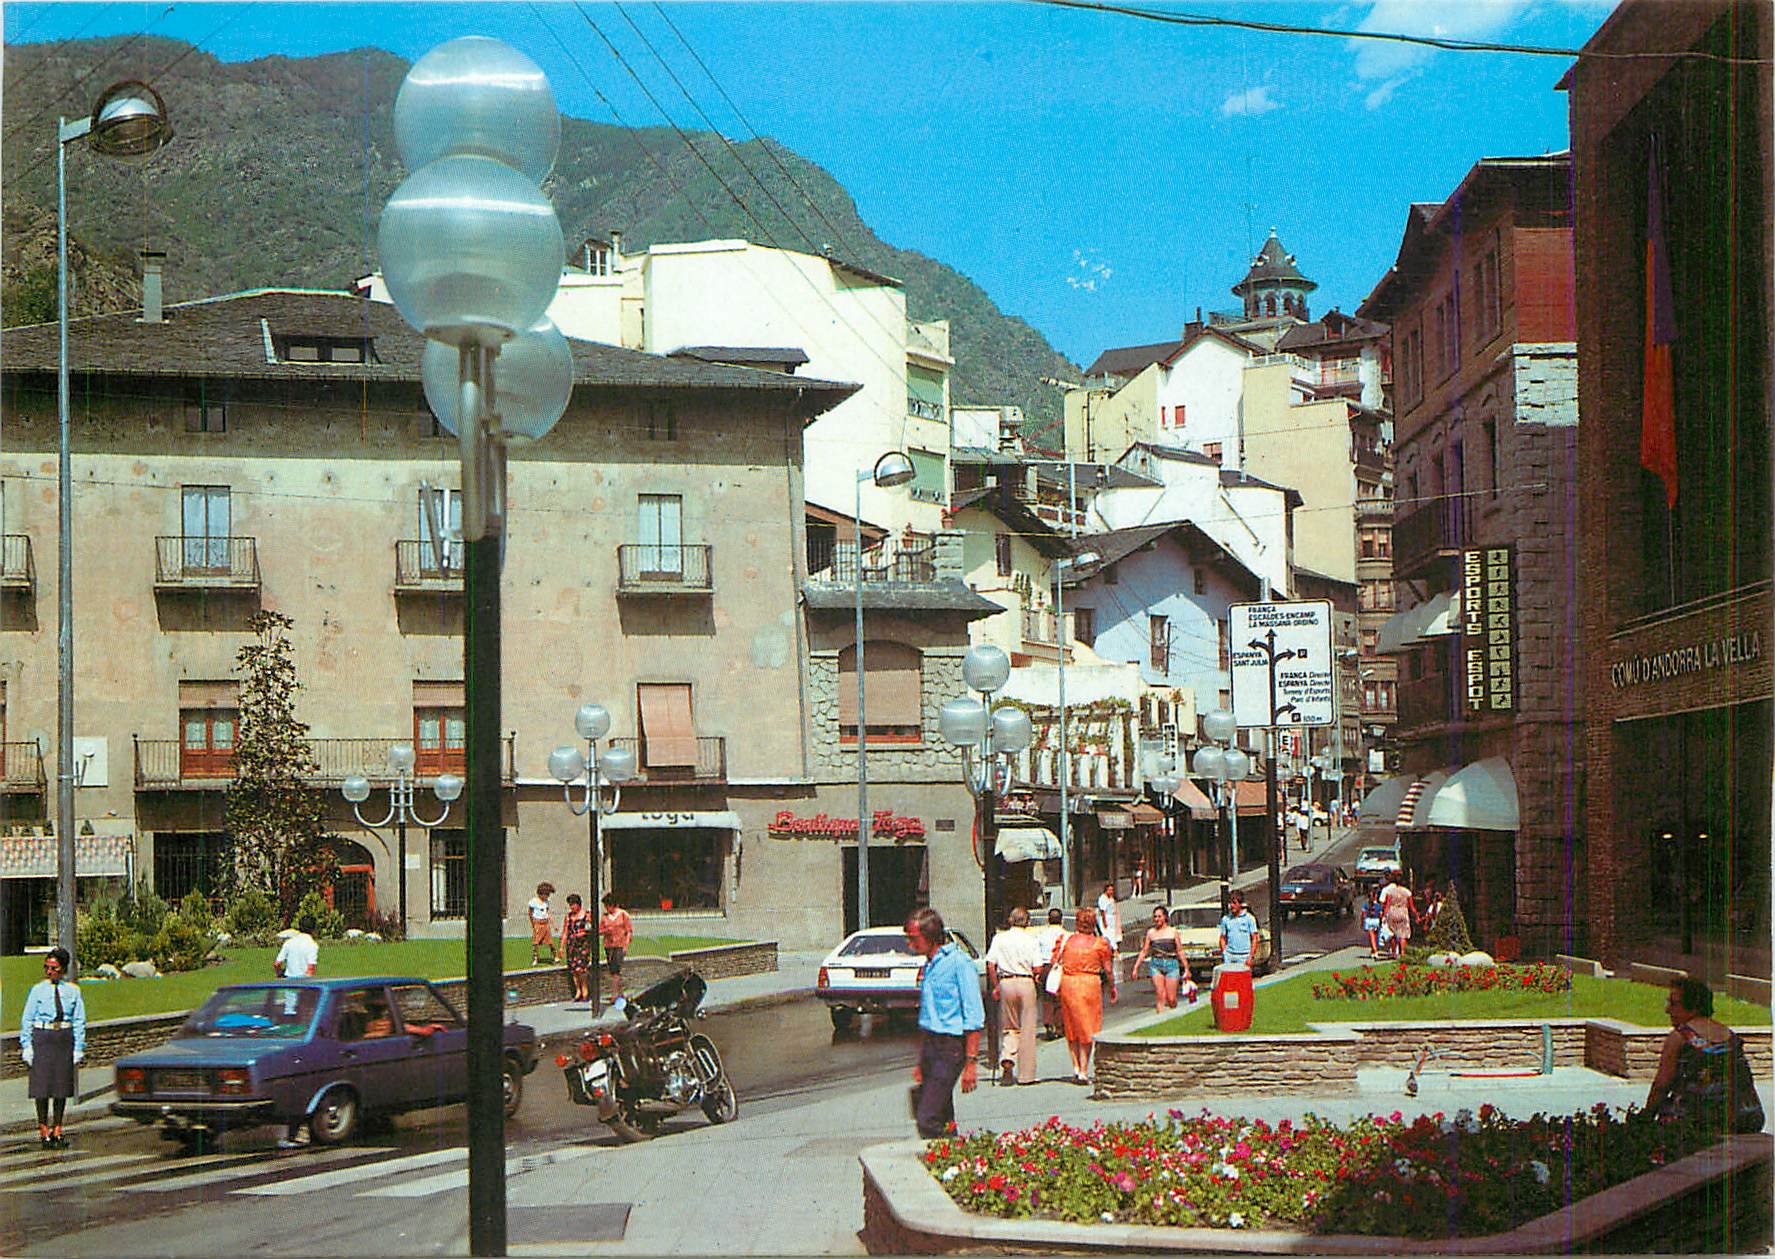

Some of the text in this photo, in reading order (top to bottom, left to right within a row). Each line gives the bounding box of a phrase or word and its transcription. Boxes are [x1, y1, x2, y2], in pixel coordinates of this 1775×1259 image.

[1248, 620, 1258, 628] LA
[1464, 551, 1484, 710] ESPORTS ESPOT
[1612, 655, 1640, 688] COMÚ
[1704, 642, 1720, 668] LA
[1721, 630, 1761, 663] VELLA
[768, 810, 927, 838] Boutique Toga
